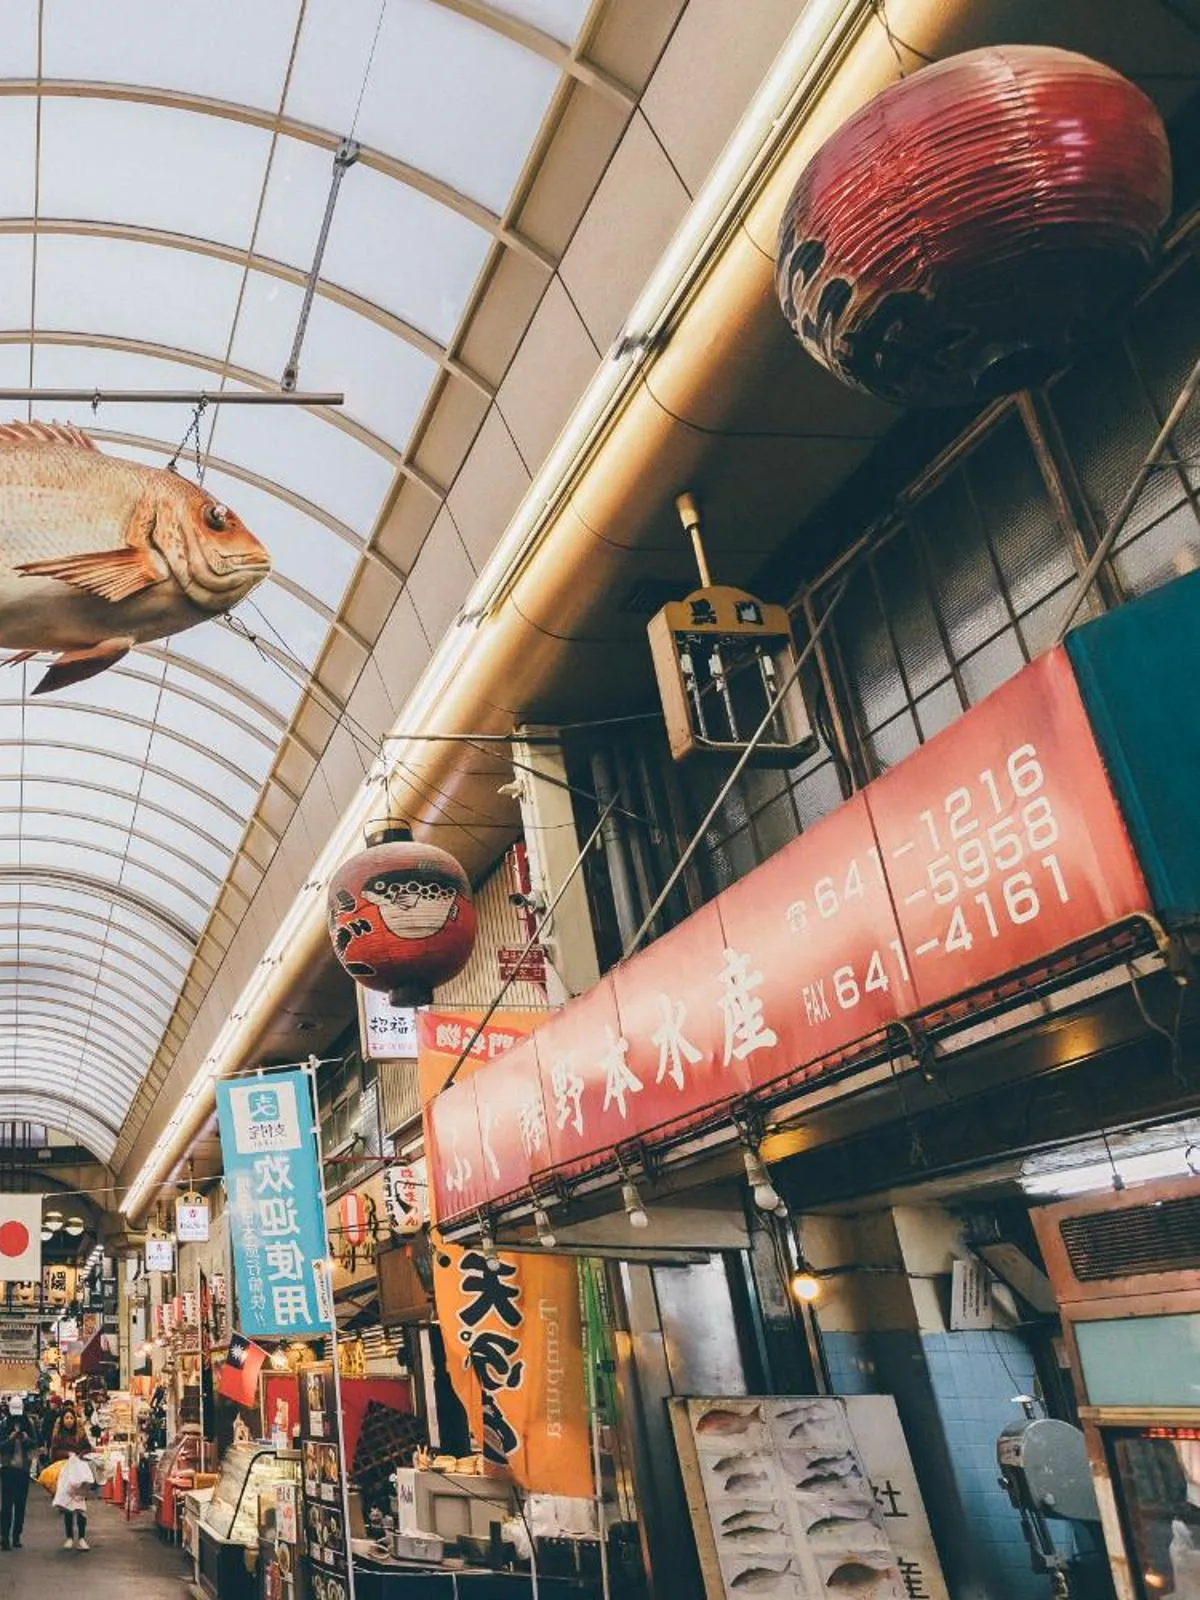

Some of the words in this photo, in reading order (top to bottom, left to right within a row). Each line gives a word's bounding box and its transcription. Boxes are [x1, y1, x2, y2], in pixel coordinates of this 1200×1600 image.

[688, 598, 764, 626] 黒門
[802, 979, 832, 1027] FAX
[832, 854, 1070, 1010] 641-4161
